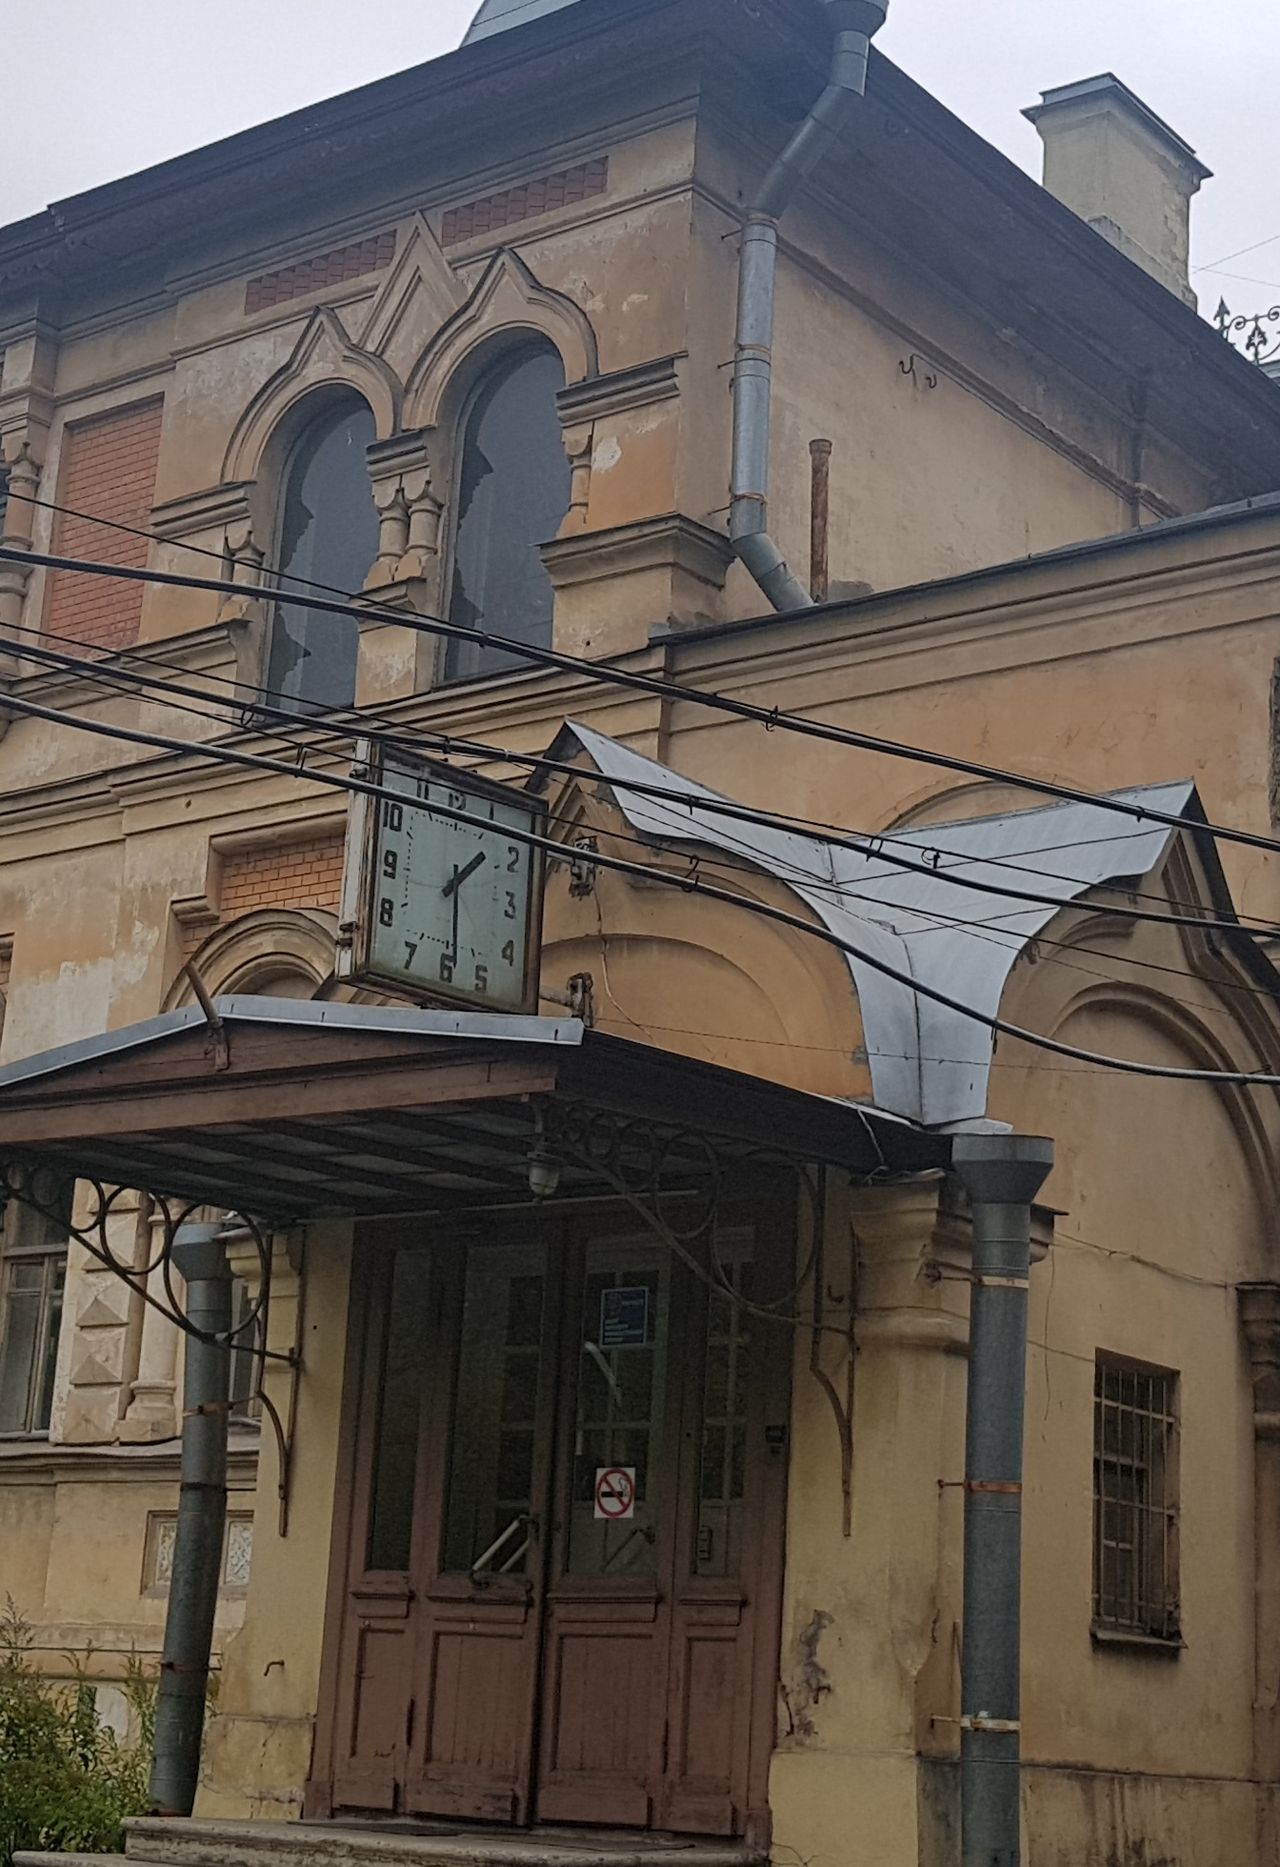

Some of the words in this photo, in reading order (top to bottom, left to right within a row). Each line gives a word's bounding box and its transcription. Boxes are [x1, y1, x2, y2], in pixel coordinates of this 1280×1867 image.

[383, 801, 403, 832] 10
[383, 849, 398, 879] 9
[507, 846, 519, 873] 2
[380, 897, 394, 927] 8
[504, 890, 516, 919] 3
[404, 941, 417, 970] 7
[440, 953, 455, 983] 6
[502, 940, 514, 967] 4
[475, 964, 488, 993] 5
